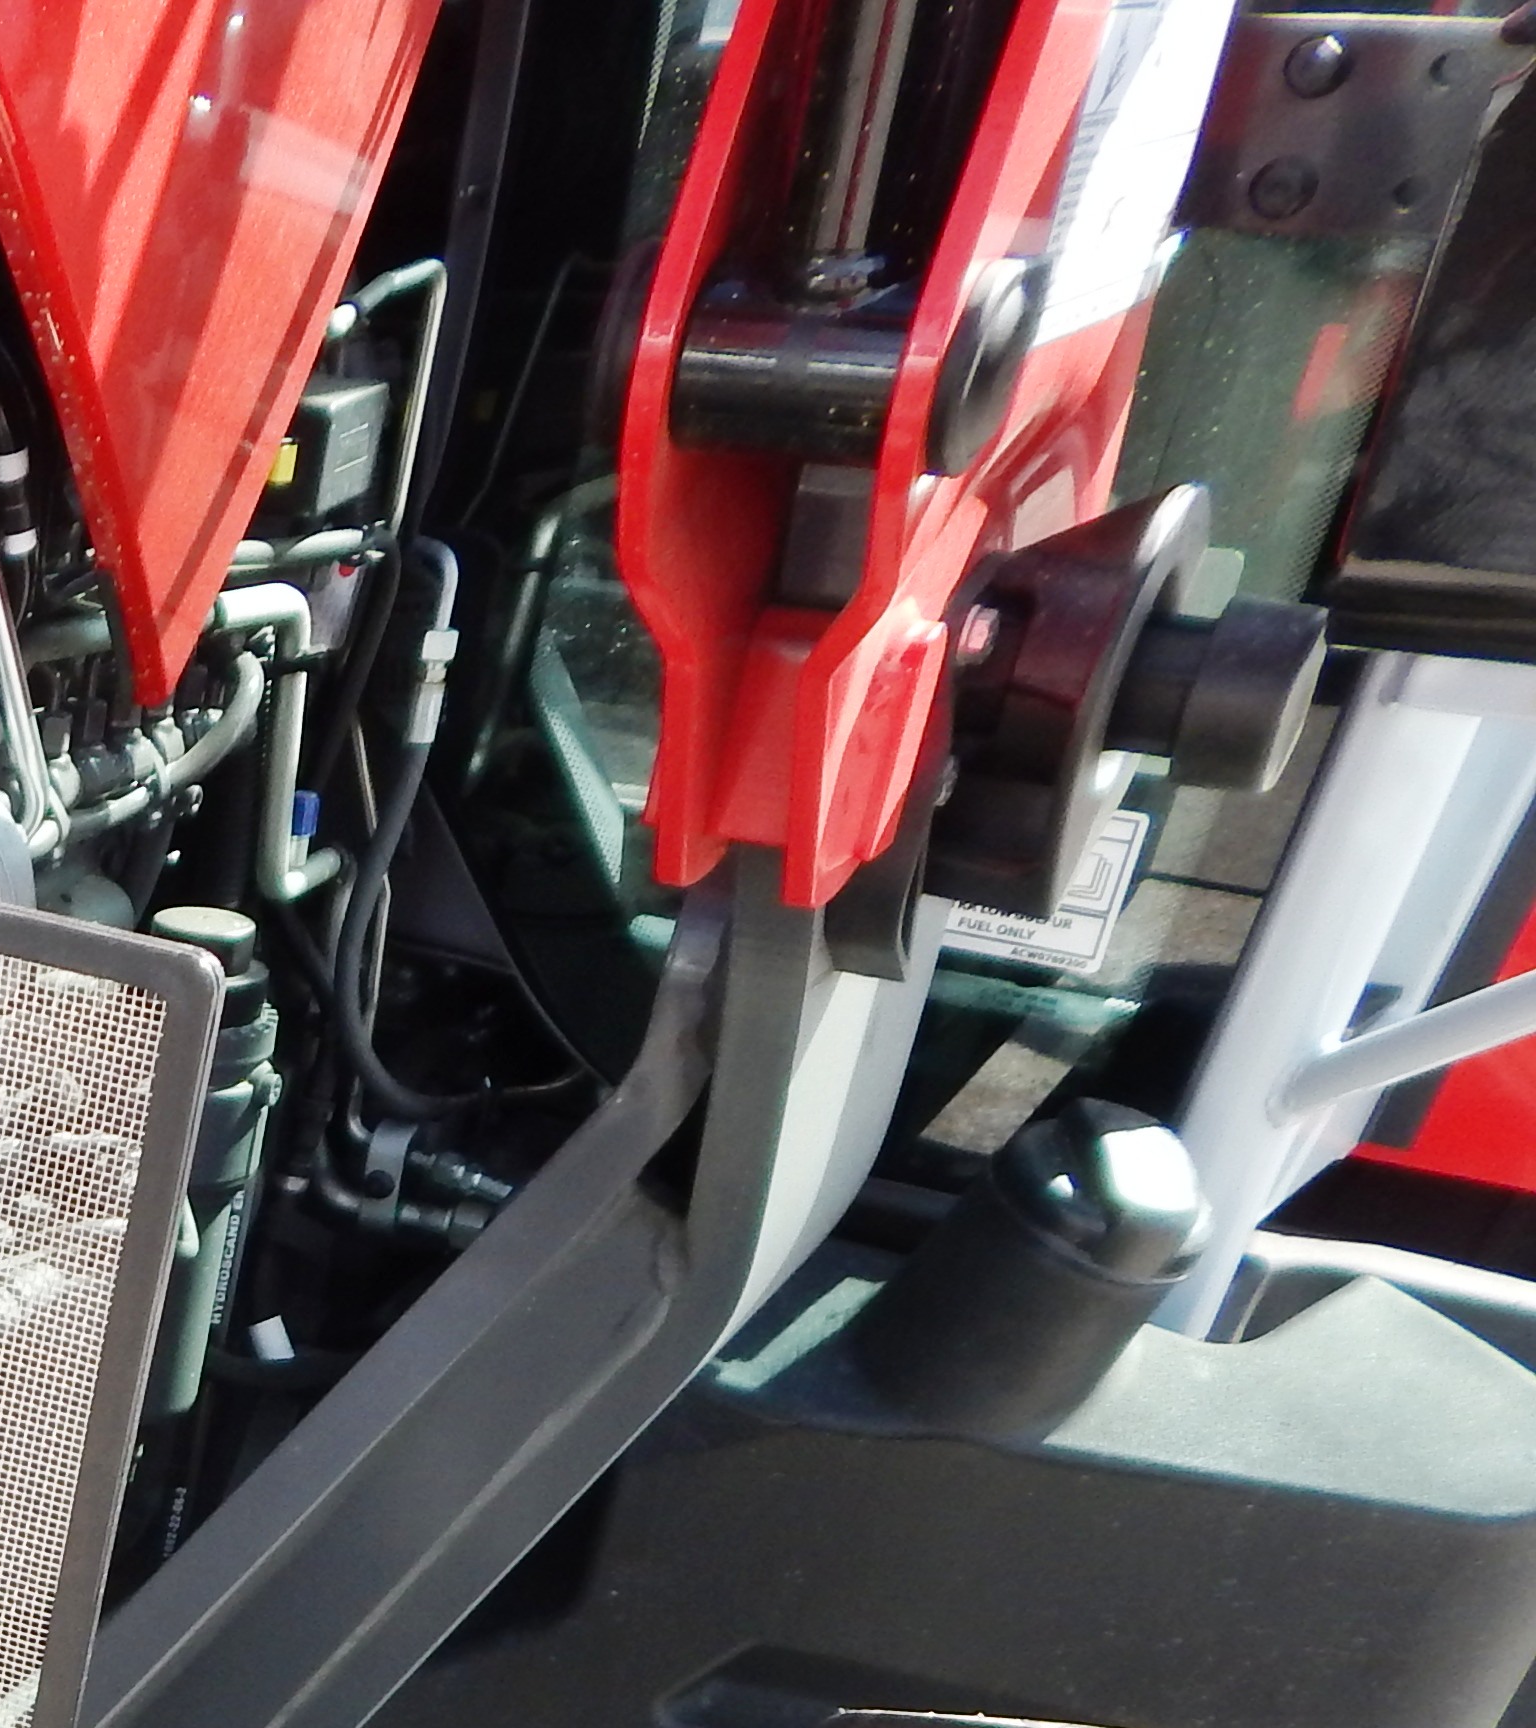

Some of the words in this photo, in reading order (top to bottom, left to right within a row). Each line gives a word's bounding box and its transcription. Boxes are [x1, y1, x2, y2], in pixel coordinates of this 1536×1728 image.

[957, 916, 993, 934] FUEL
[996, 923, 1036, 940] ONLY
[210, 1214, 241, 1325] HYDROSCAND
